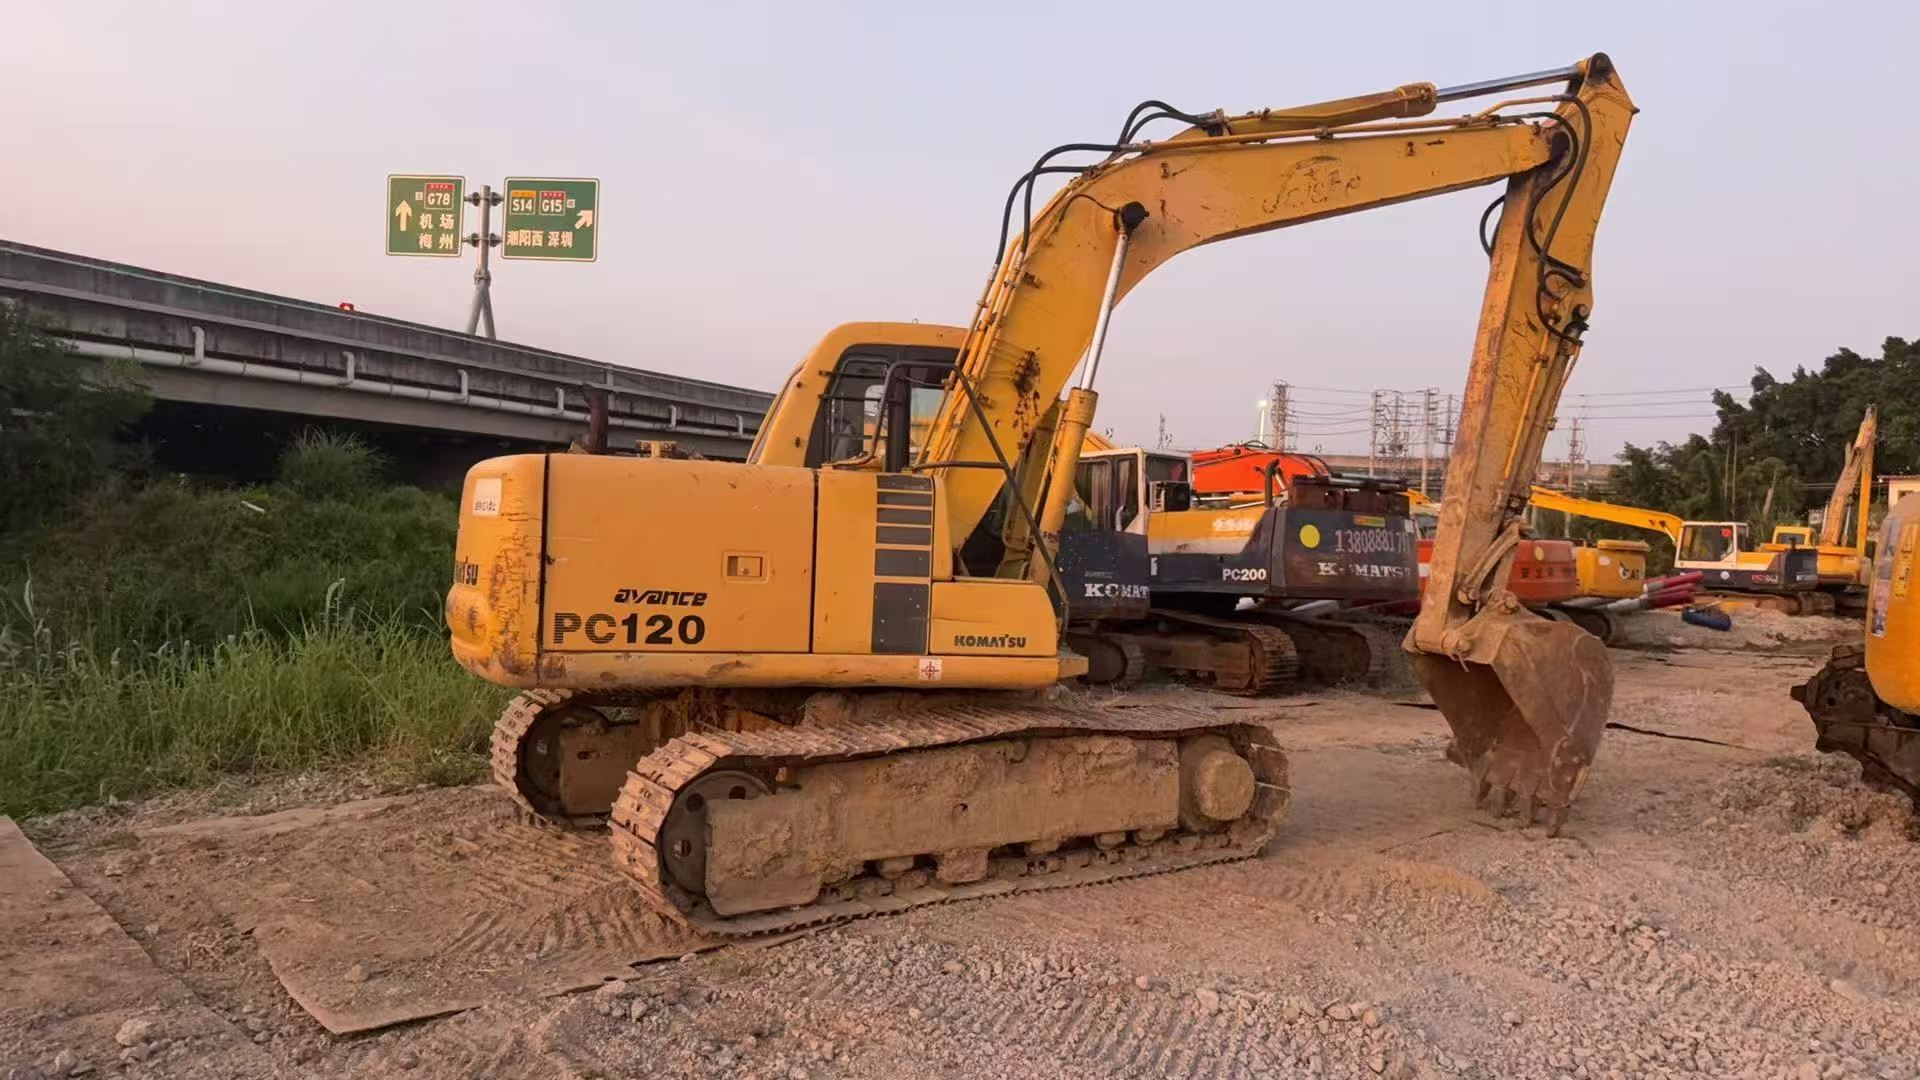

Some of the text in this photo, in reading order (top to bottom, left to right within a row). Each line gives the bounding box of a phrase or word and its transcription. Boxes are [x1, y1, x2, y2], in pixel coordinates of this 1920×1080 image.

[428, 193, 450, 206] G78
[512, 199, 532, 211] S14
[542, 200, 562, 212] G15
[419, 213, 454, 229] 机场
[419, 233, 454, 249] 梅州
[548, 231, 573, 248] 深圳
[1223, 568, 1267, 581] PC200
[553, 613, 705, 644] PC120
[954, 634, 1027, 648] KOMATSU
